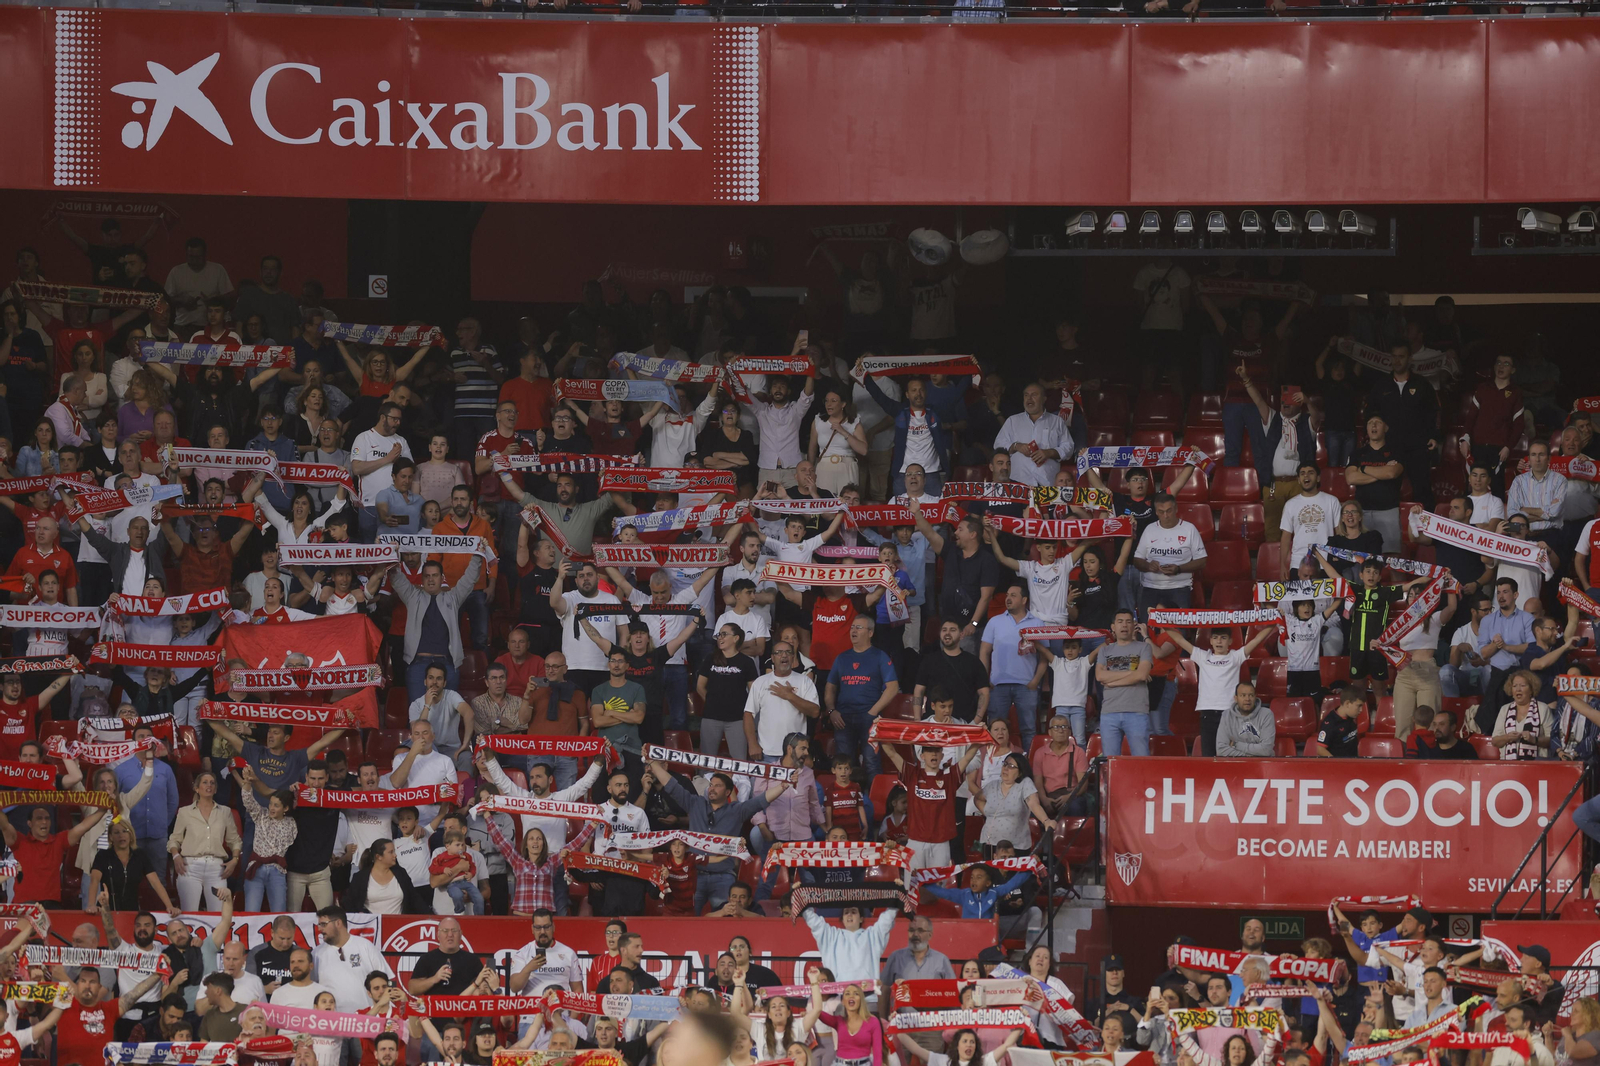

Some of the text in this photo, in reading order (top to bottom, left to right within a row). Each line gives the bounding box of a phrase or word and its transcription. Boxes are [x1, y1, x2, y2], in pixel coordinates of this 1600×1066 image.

[250, 62, 703, 153] CaixaBank
[102, 291, 142, 307] BIRIS
[157, 346, 195, 360] SCHALKE
[196, 347, 207, 359] 04
[565, 379, 597, 390] Sevilla
[605, 380, 627, 388] COPA
[177, 454, 271, 466] UNCA ME RINDO
[1088, 451, 1121, 461] SCHALKE
[1121, 452, 1132, 461] 04
[1147, 450, 1178, 460] SEVILLA
[605, 473, 648, 485] Sevilla
[690, 473, 734, 487] Sevilla
[85, 490, 119, 503] Sevilla
[883, 510, 897, 520] TE
[379, 536, 475, 547] NUNCA TE RINDAS
[1436, 522, 1531, 558] NUNCA ME RINDO
[288, 546, 392, 559] NUNCA ME RINDO
[605, 547, 718, 562] BIRIS NORTE
[1150, 546, 1183, 557] Playtika
[777, 565, 885, 580] ANTIBETICOS
[588, 603, 687, 612] ETERNO CAPITAN
[7, 610, 97, 623] SUPERCOPA
[1155, 611, 1194, 625] SEVILLA
[1232, 611, 1255, 624] CLUB
[117, 650, 216, 662] NUNCA TE RINDAS
[244, 670, 368, 687] BIRIS NORTE
[495, 738, 599, 752] NUNCA TE RINDAS
[651, 746, 763, 776] SEVILLA
[27, 768, 50, 781] Club
[327, 788, 430, 803] NUNCA TE RINDAS
[505, 797, 525, 808] 100
[539, 801, 604, 816] SEVILLISTA
[1145, 777, 1548, 835] ¡HAZTE SOCIO!
[600, 823, 635, 832] Pytika
[790, 847, 844, 861] Sevilla
[1236, 838, 1452, 859] BECOME A MEMBER!
[585, 854, 640, 873] SUPERCOPA
[1180, 947, 1329, 979] FINAL COPA
[261, 967, 293, 979] Playtik
[563, 991, 597, 1002] Sevilla
[435, 998, 540, 1011] NUNCA TE RINDAS
[262, 1007, 381, 1034] MujerSevillista
[895, 1011, 938, 1029] SEVILLA
[977, 1009, 1002, 1026] CLUB
[1447, 1031, 1515, 1044] SEVILLA FC
